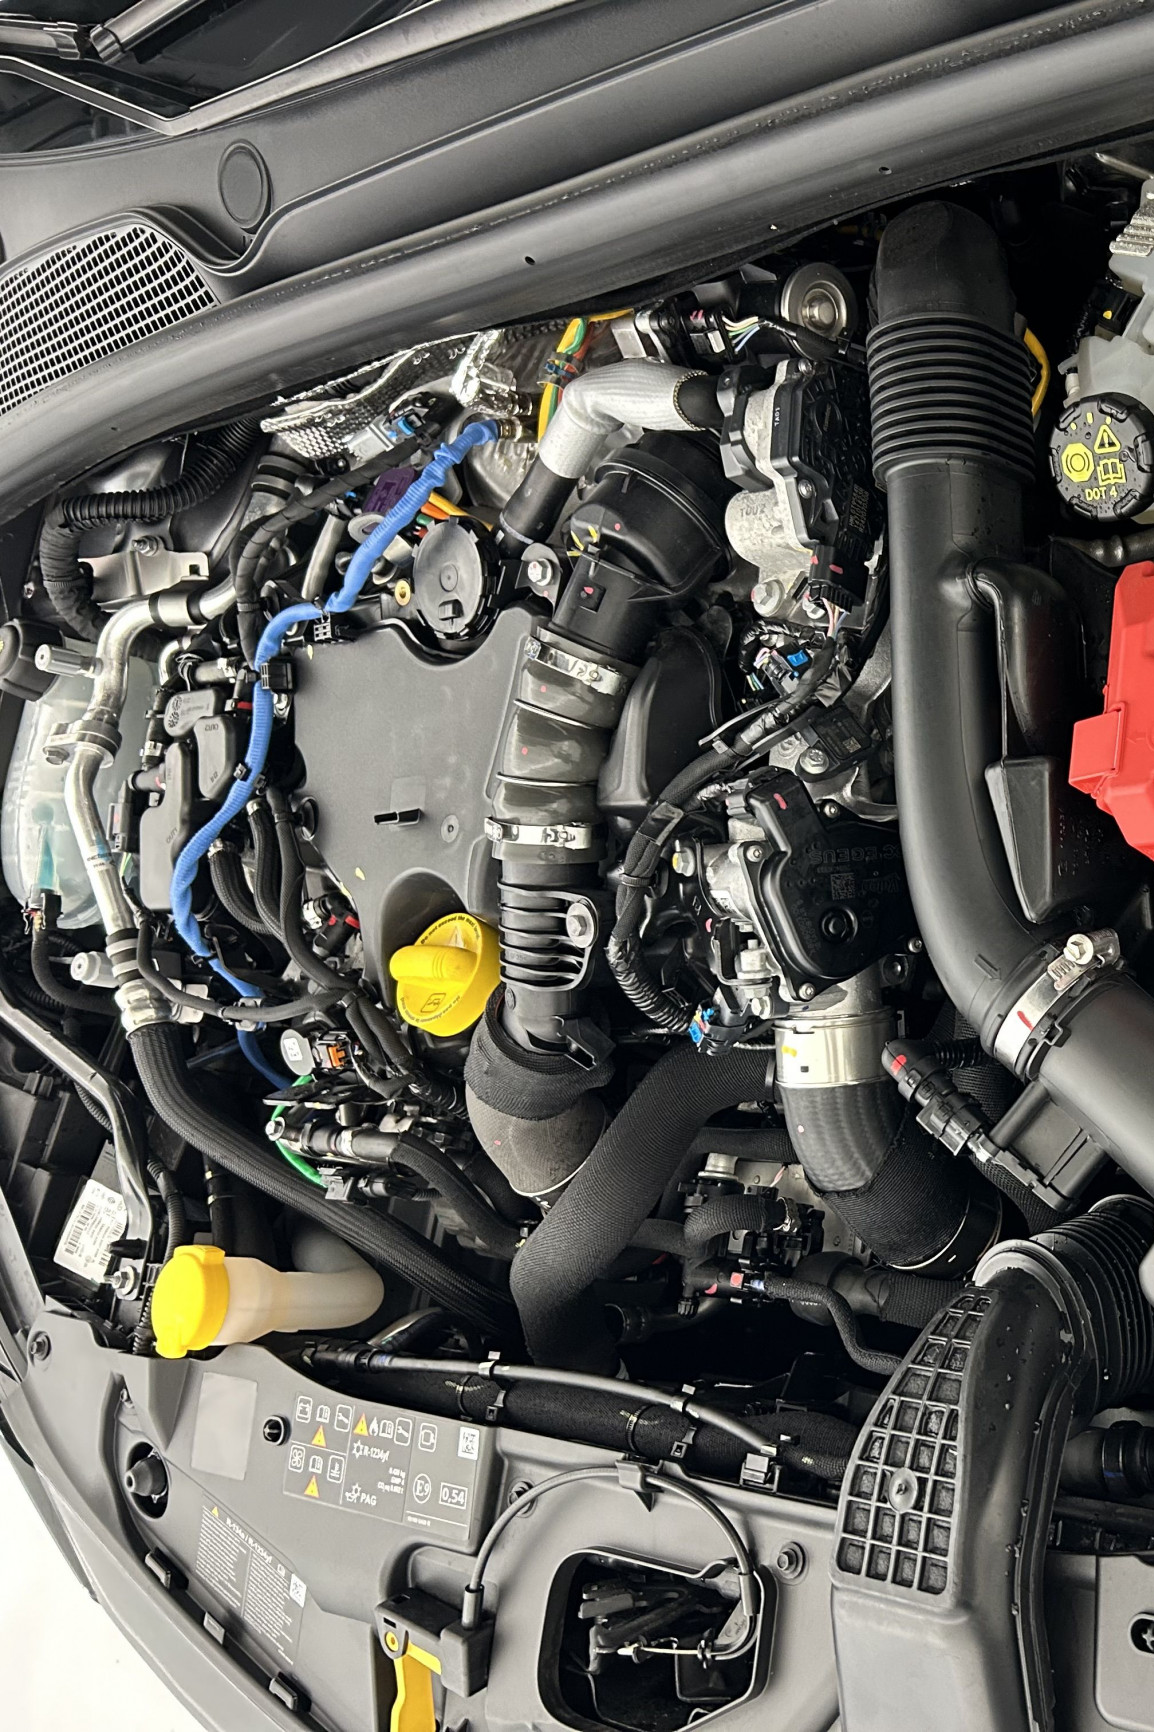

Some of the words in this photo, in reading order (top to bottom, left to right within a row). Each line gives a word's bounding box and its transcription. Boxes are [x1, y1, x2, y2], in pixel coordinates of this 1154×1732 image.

[1085, 487, 1106, 500] DOT
[1110, 486, 1117, 497] 4
[363, 1444, 390, 1463] R-1234yf
[415, 1479, 430, 1496] E9
[442, 1490, 465, 1504] 0,54
[360, 1494, 377, 1506] PAG
